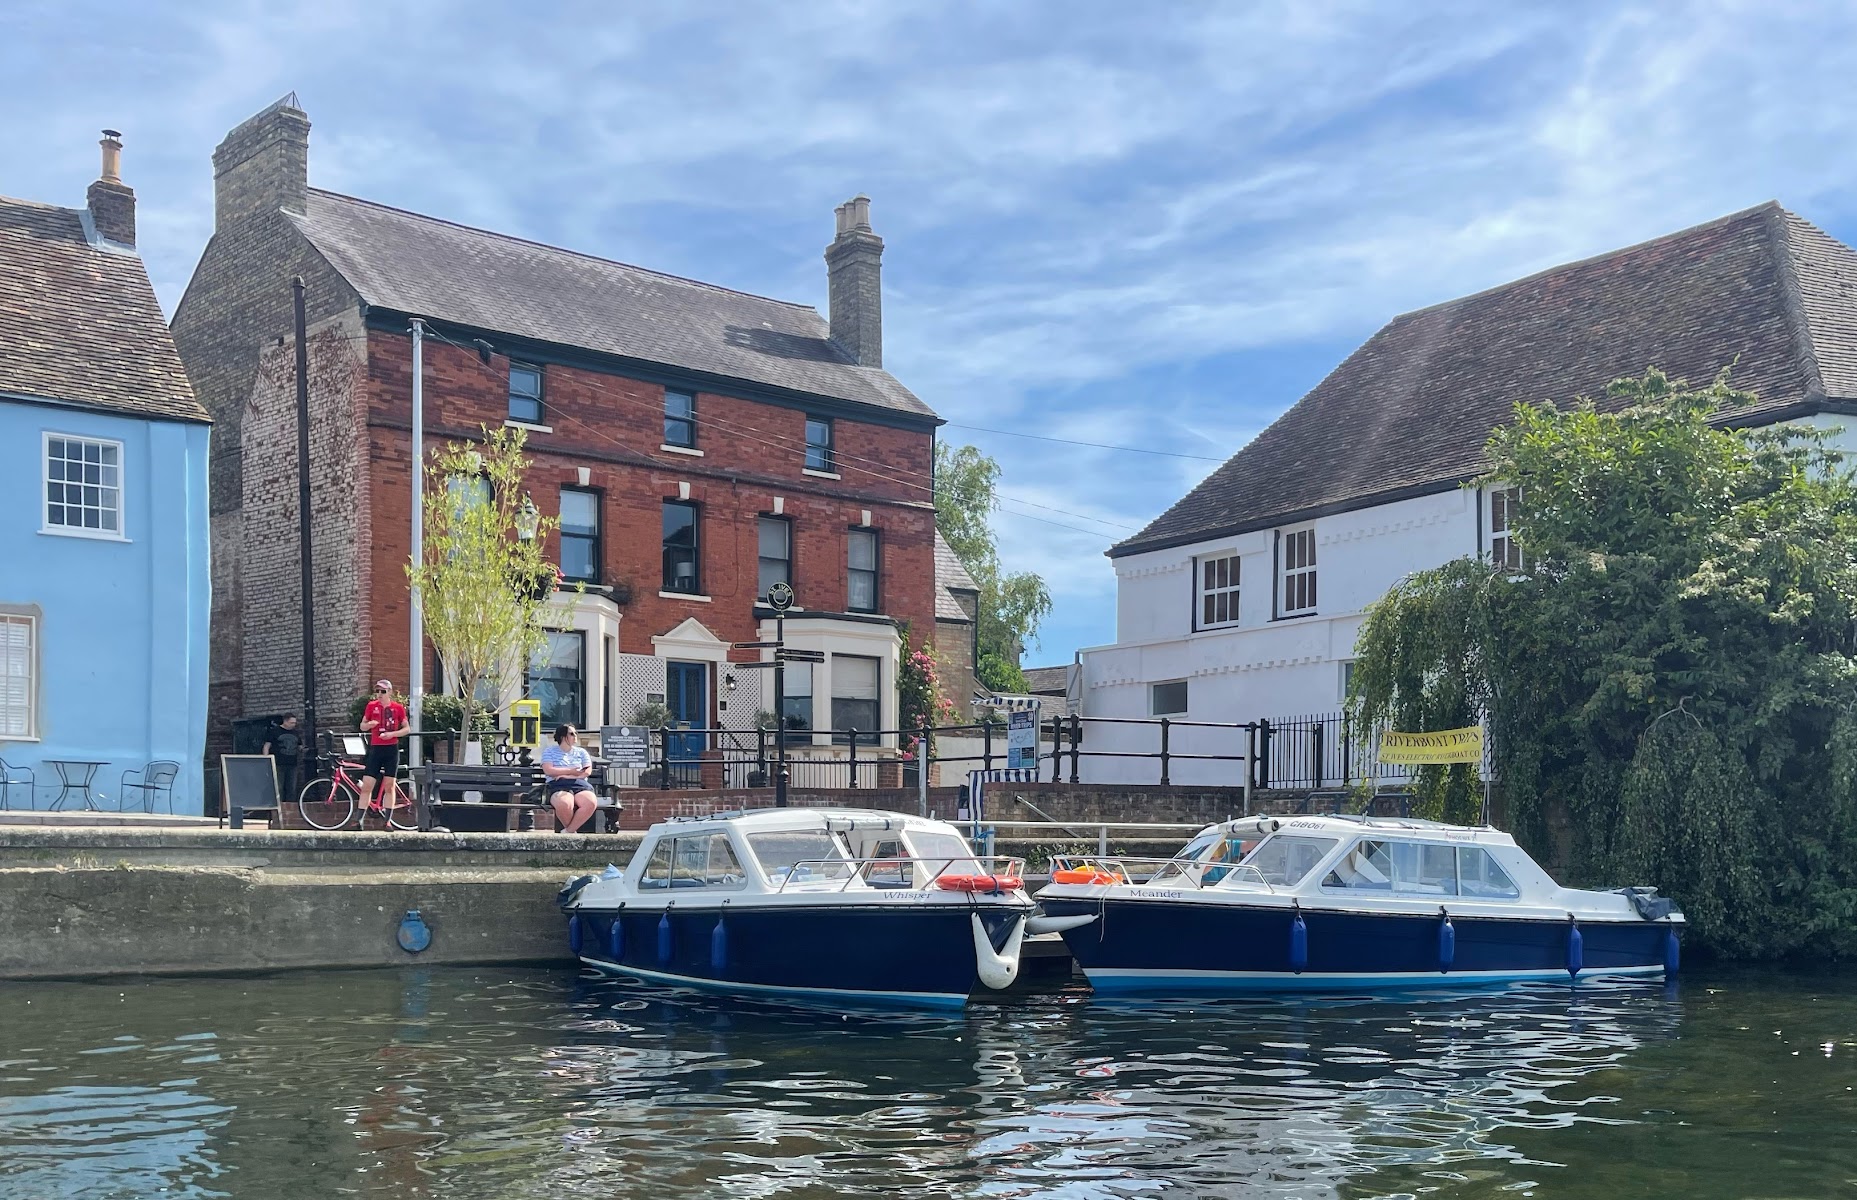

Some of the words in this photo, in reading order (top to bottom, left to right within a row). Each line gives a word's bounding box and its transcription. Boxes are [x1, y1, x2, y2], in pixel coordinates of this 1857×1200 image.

[778, 584, 792, 597] IVES
[1385, 734, 1448, 747] RIVERBOAT
[1450, 731, 1479, 746] TRIPS
[1469, 750, 1480, 758] CO
[883, 891, 933, 900] Whisper
[1130, 889, 1184, 899] Meander
